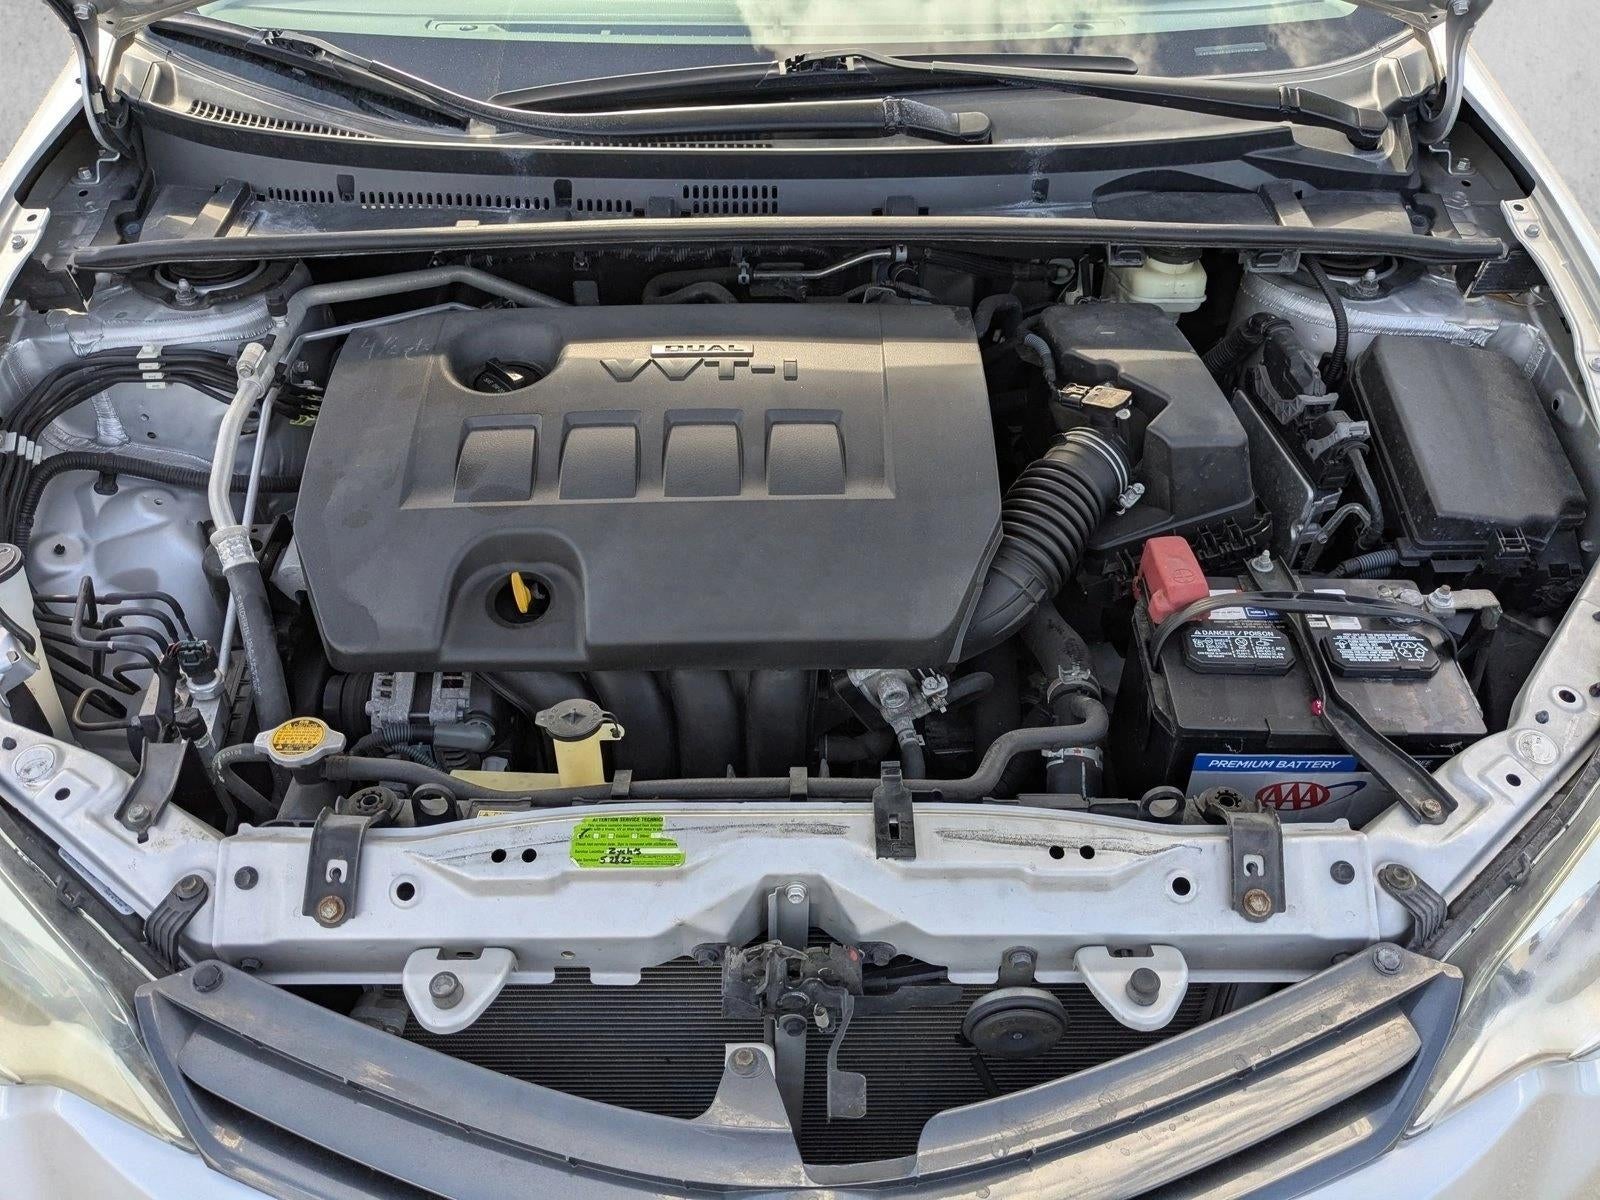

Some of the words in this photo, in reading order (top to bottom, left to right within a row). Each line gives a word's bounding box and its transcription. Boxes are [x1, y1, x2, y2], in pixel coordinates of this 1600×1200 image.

[664, 344, 744, 352] DUAL
[1208, 760, 1273, 768] PREMIUM
[1276, 760, 1342, 768] BATTERY
[1260, 782, 1322, 810] AAA
